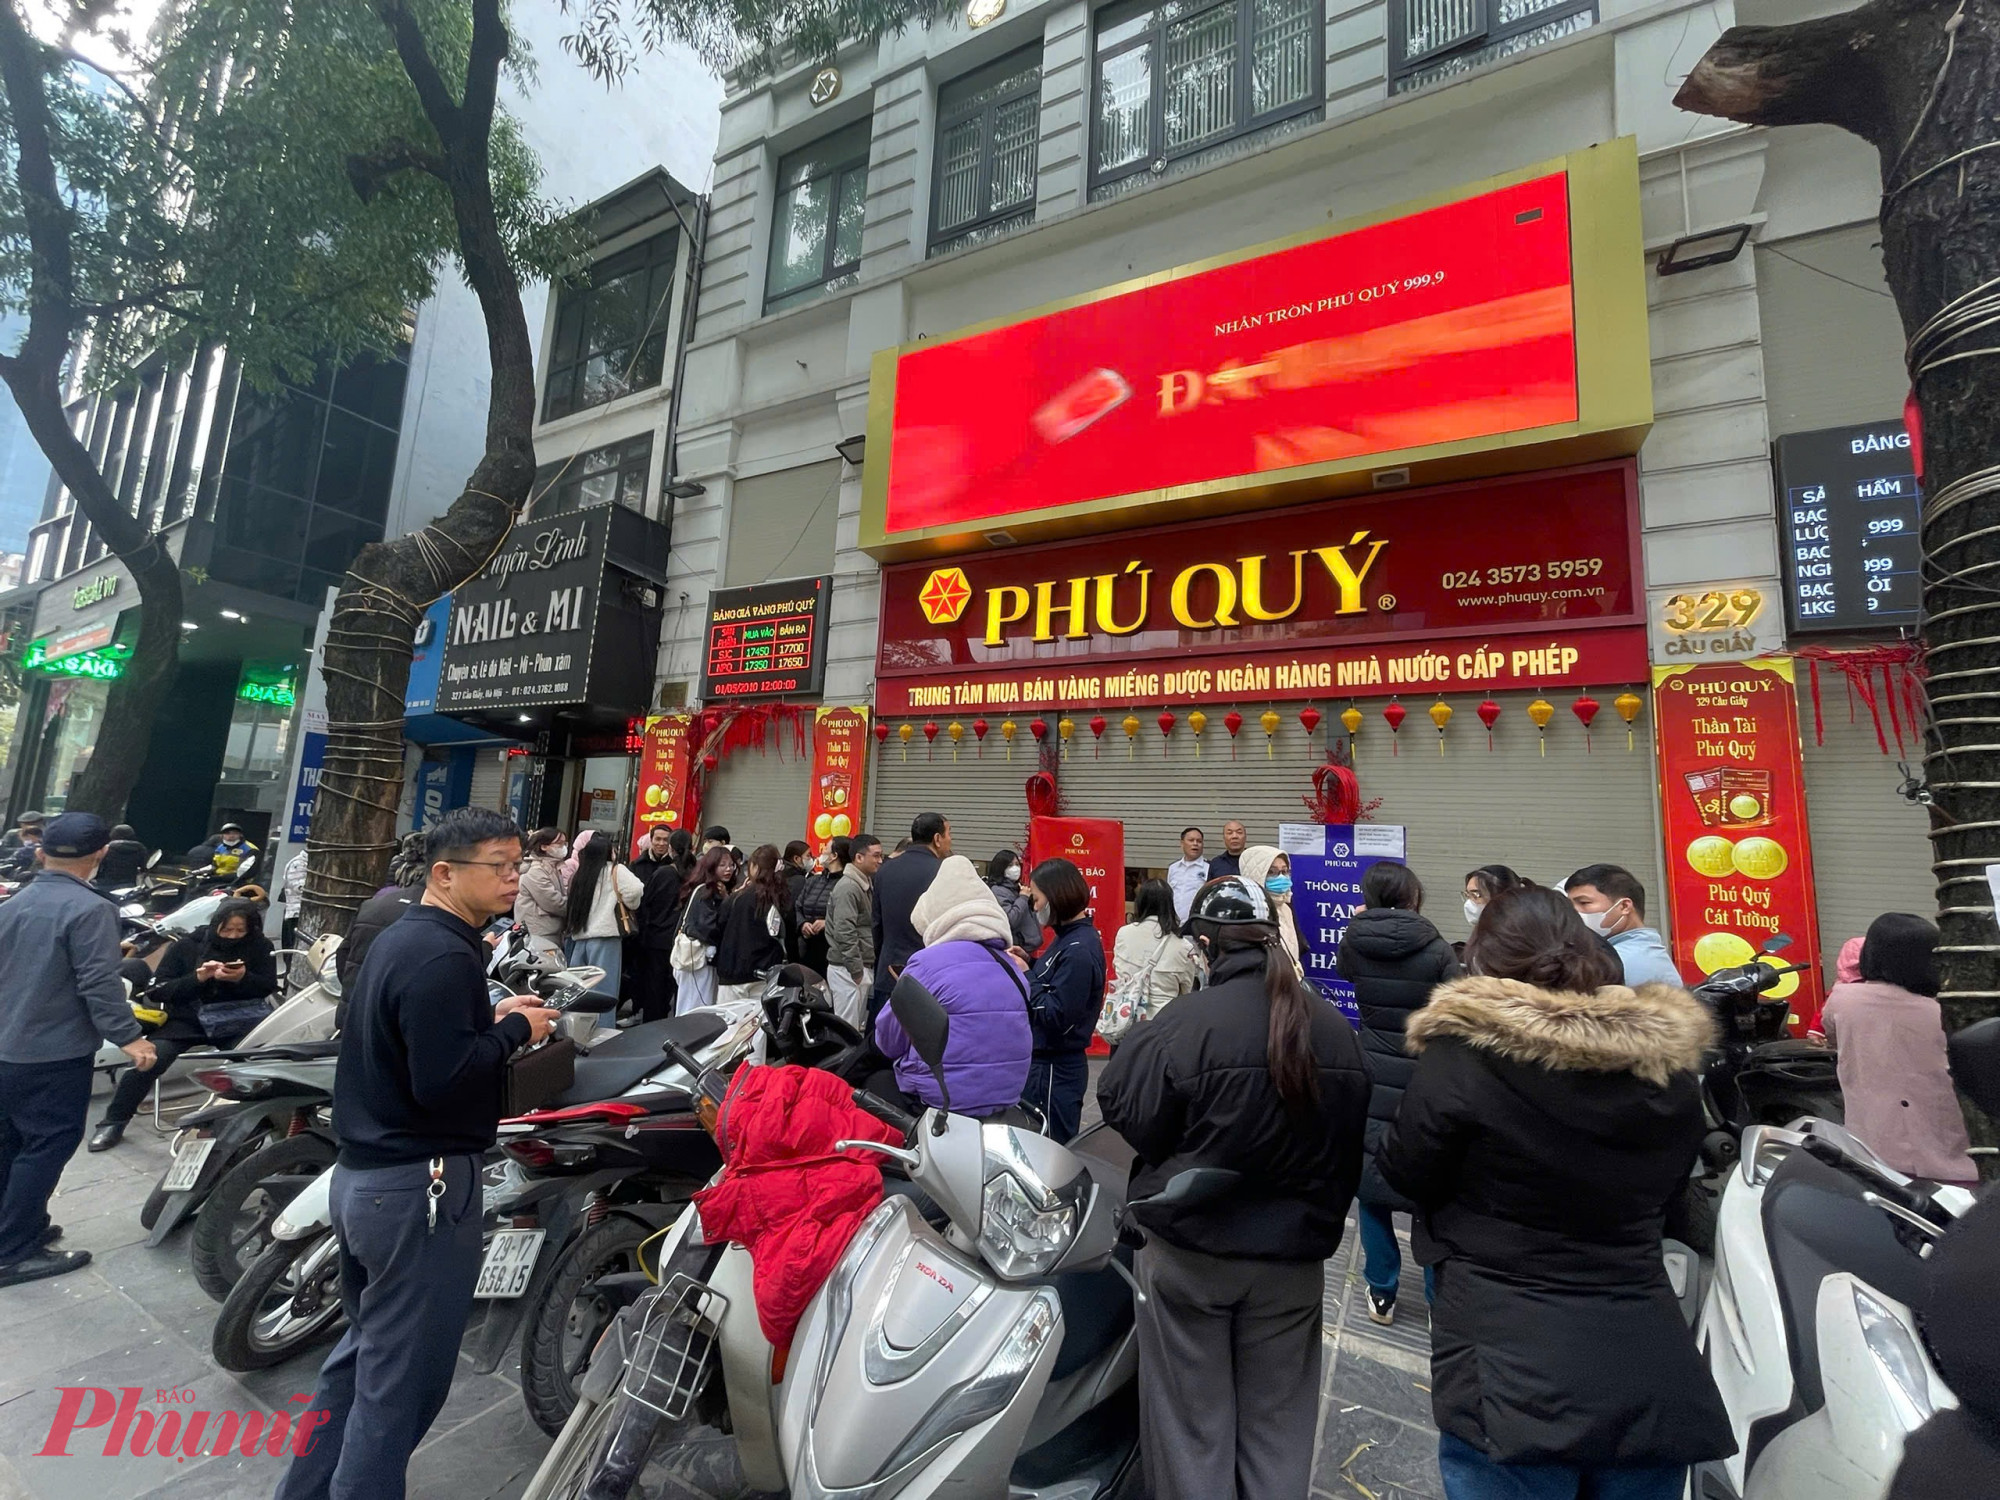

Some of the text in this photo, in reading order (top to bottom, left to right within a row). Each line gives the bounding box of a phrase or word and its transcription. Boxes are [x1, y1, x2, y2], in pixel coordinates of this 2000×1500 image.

[1265, 302, 1313, 325] TRÒN
[1317, 291, 1354, 313] PHÚ
[1358, 279, 1399, 302] QUÝ
[1851, 432, 1912, 454] BẢNG
[1801, 485, 1826, 504] SẢ
[1793, 508, 1828, 526] BẠC
[481, 519, 587, 592] uyền Linh
[1796, 545, 1832, 562] BẠC
[1442, 557, 1603, 589] 024 3573 5959
[982, 529, 1390, 646] PHÚ QUÝ
[1457, 586, 1605, 607] www.phuquy.com.vn
[1800, 581, 1835, 600] BẠC
[452, 598, 517, 646] NAIL
[520, 611, 538, 635] &
[543, 586, 584, 633] MI
[736, 606, 751, 619] GIÁ
[752, 604, 776, 617] VÀNG
[776, 600, 794, 614] PHÚ
[795, 597, 815, 612] QUÝ
[1664, 589, 1761, 630] 329
[795, 624, 806, 635] RA
[718, 643, 804, 660] SJC 17450 17700
[1664, 630, 1756, 655] CẦU GIẤY
[534, 653, 552, 672] Phun
[744, 659, 768, 671] 17350
[778, 656, 803, 668] 17650
[908, 642, 1579, 707] TRUNG TÂM MUA BÁN VÀNG MIẾNG ĐƯỢC NGÂN HÀNG NHÀ NƯỚC CẤP PHÉP
[715, 679, 796, 695] 01/05/2010 12:00:00
[1687, 678, 1772, 695] PHÚ QUÝ
[1695, 697, 1711, 707] 329
[1691, 716, 1758, 735] Thần Tài
[1695, 739, 1757, 761] Phú Quý
[1086, 866, 1106, 877] BÁO
[1324, 859, 1341, 867] PHÚ
[1304, 879, 1349, 892] THÔNG
[1708, 883, 1772, 909] Phú Quý
[1704, 907, 1780, 934] Cát Tường
[491, 1234, 537, 1263] 29-Y7
[915, 1261, 954, 1294] HONDA
